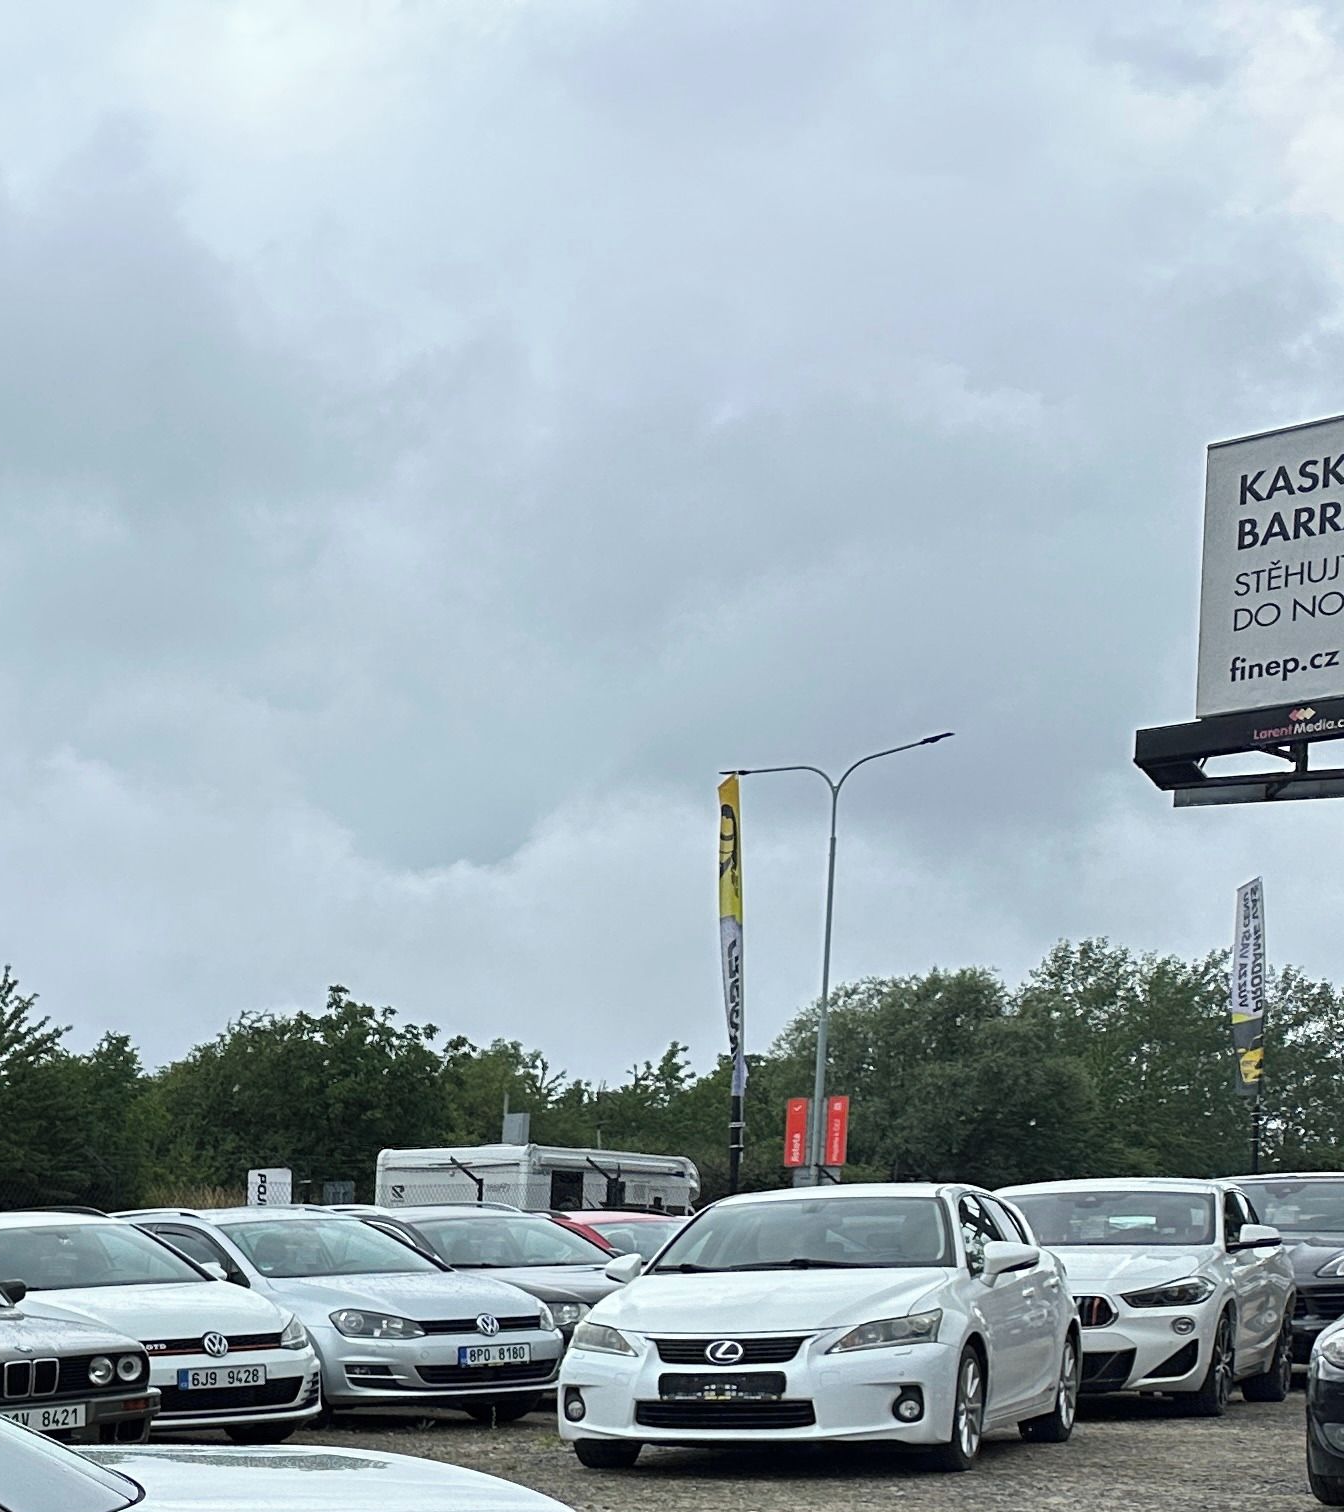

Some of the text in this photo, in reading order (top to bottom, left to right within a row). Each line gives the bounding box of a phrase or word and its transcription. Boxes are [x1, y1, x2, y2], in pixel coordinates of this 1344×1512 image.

[1239, 453, 1344, 505] KASK
[1238, 502, 1344, 551] BARR
[1234, 555, 1344, 597] STĚHUJ
[1233, 602, 1281, 632] DO
[1230, 650, 1340, 682] finep.cz
[192, 1368, 259, 1387] 6J9 9428
[3, 1408, 79, 1427] 1V 8421
